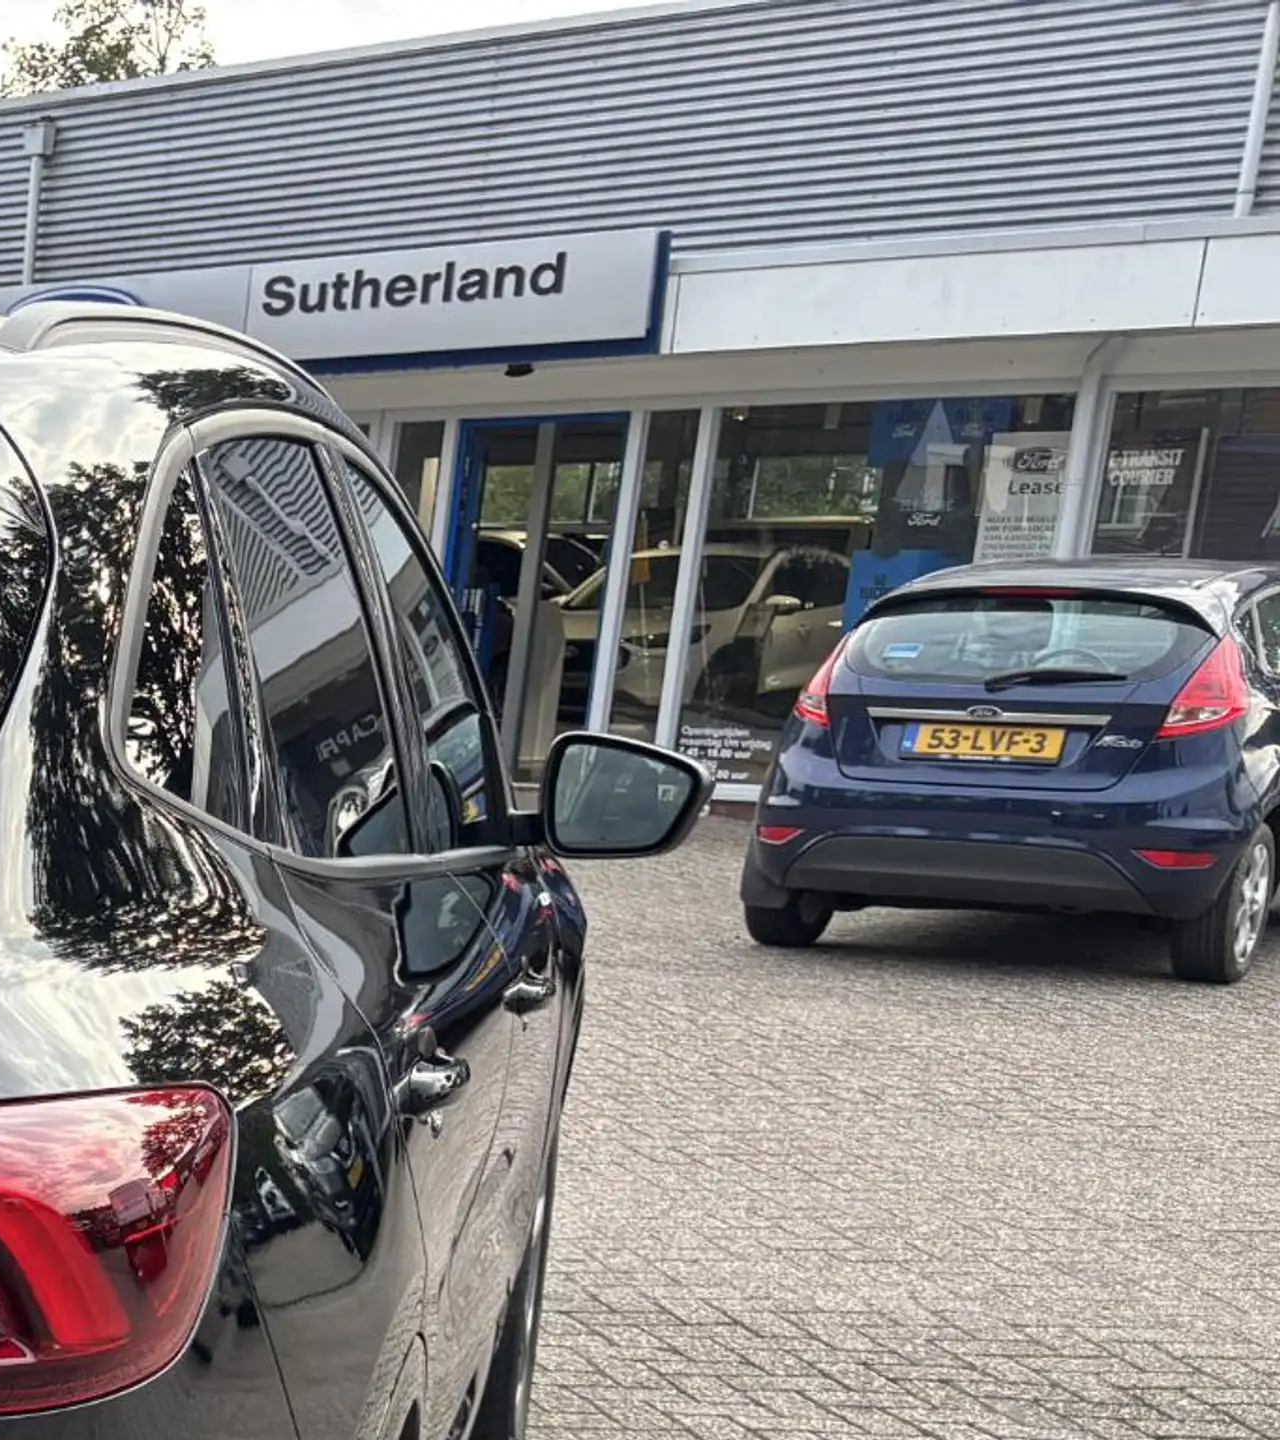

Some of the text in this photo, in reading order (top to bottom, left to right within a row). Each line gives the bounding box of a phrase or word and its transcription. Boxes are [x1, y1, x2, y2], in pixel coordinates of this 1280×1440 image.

[262, 251, 567, 317] Sutherland
[1109, 449, 1185, 467] E-TRANSIT
[1109, 469, 1175, 486] COURIER
[927, 728, 1047, 753] 53-LVF-3
